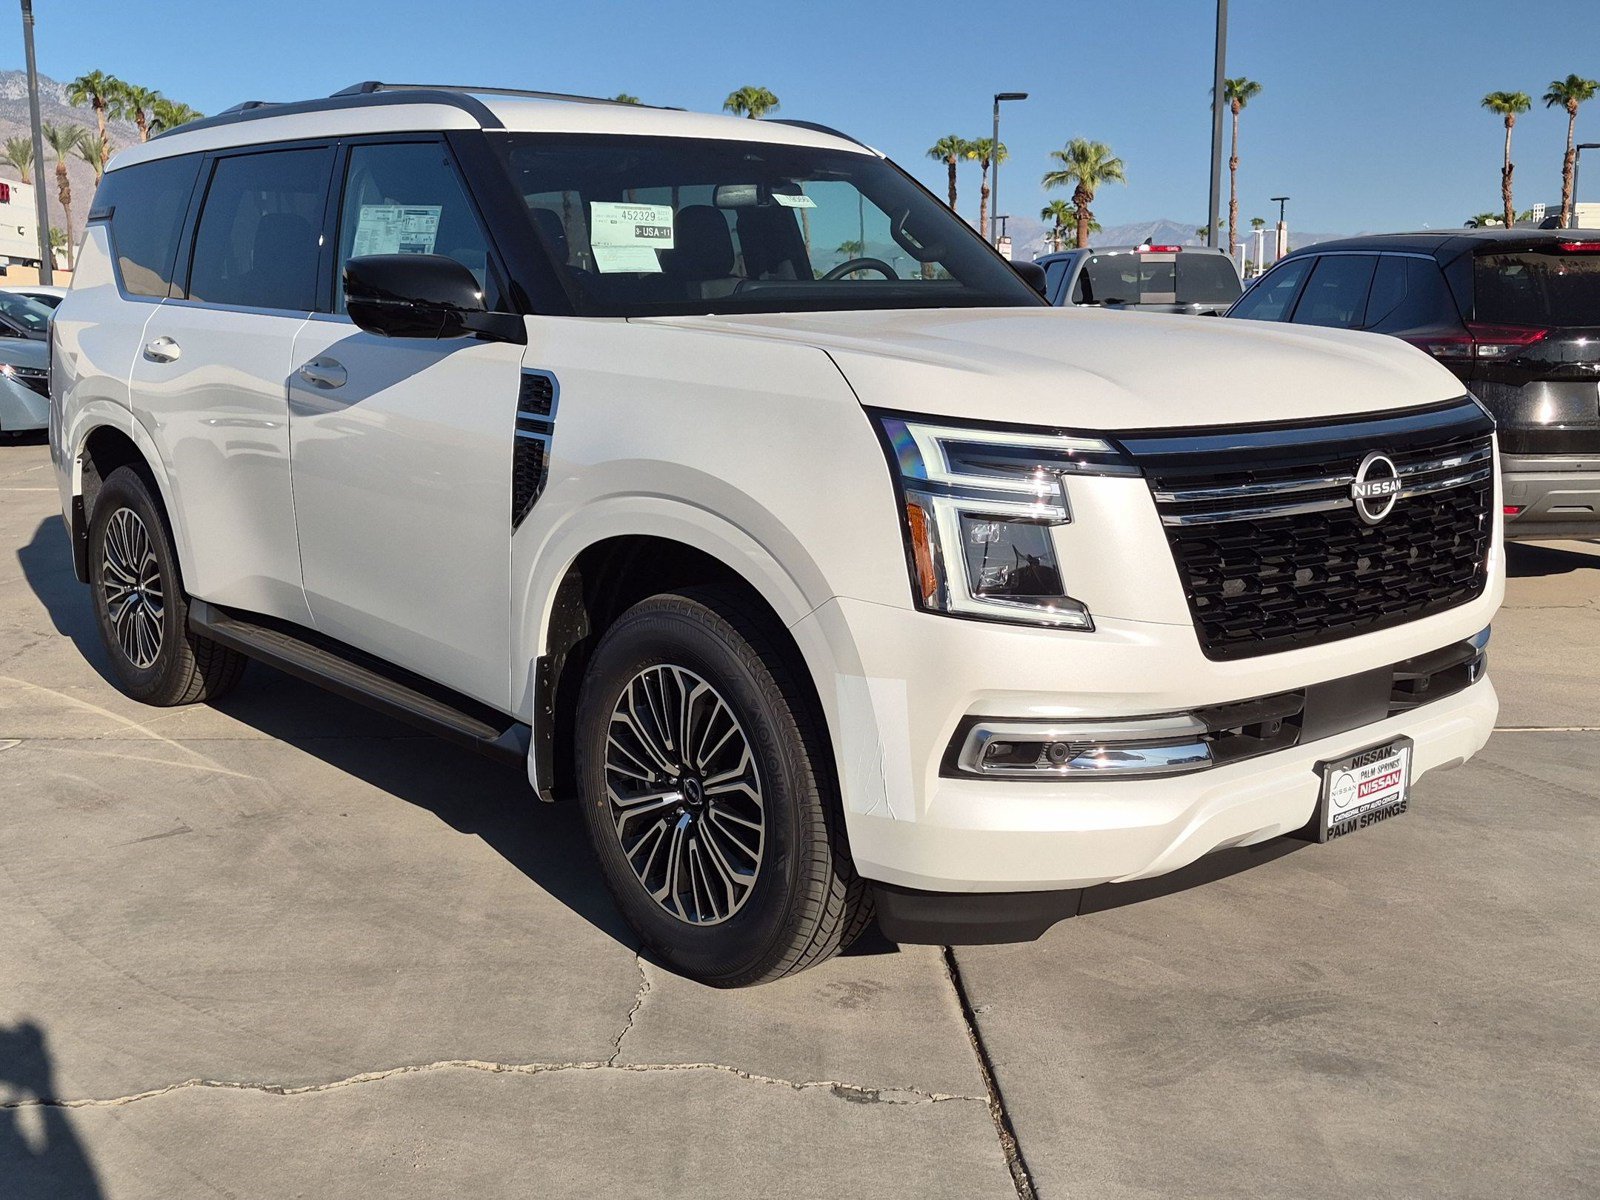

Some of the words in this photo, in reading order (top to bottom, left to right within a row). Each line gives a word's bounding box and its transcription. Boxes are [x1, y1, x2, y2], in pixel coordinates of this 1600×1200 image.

[622, 210, 656, 222] 452329
[643, 227, 659, 236] USA
[1354, 479, 1402, 497] NISSAN
[1352, 746, 1392, 769] NISSAN
[1360, 767, 1376, 780] PALM
[1378, 759, 1400, 773] SPRINGS
[1332, 785, 1356, 796] NISSAN
[1360, 772, 1400, 797] NISSAN
[1360, 804, 1370, 812] CITY
[1327, 819, 1357, 841] PALM
[1360, 801, 1407, 828] SPRINGS
